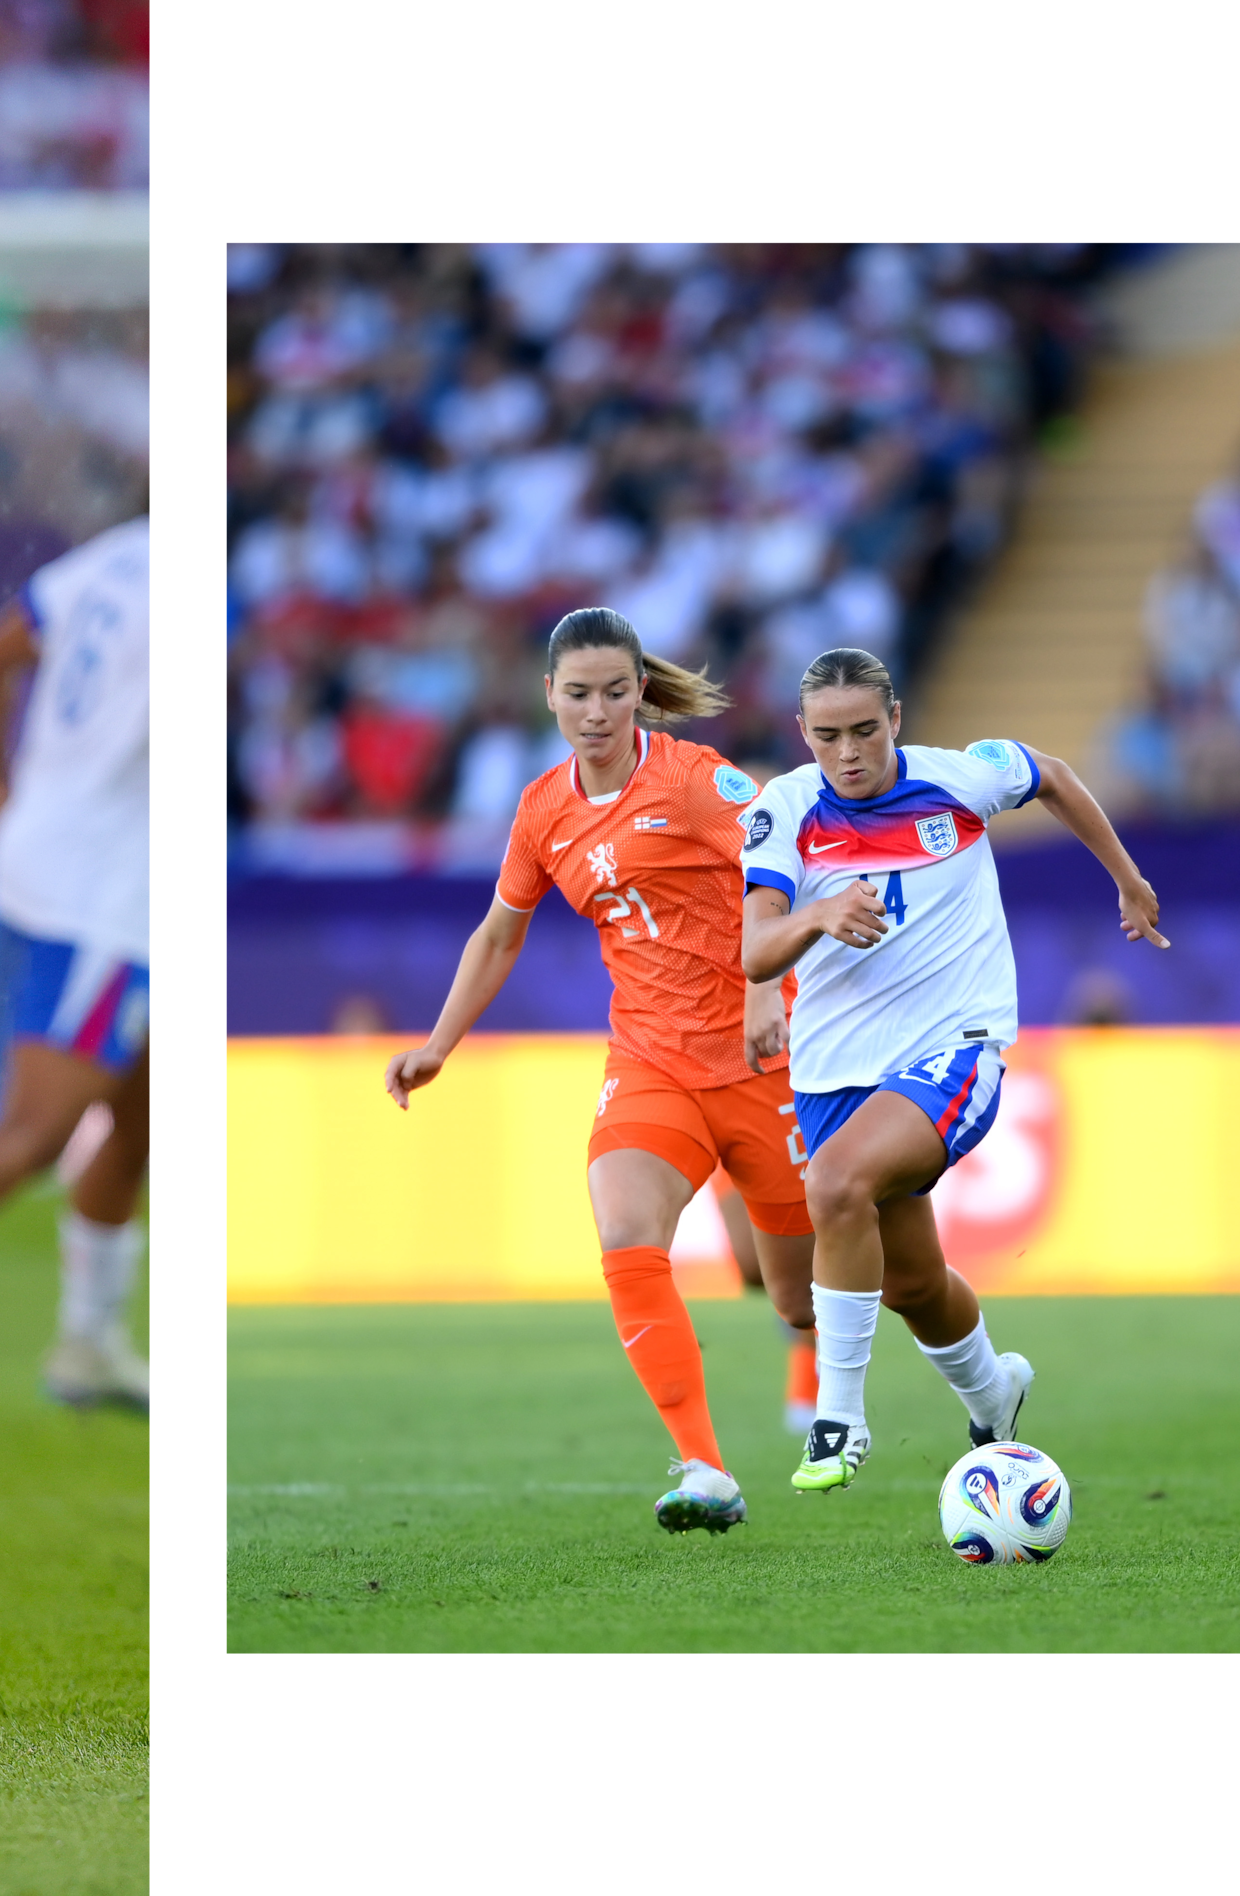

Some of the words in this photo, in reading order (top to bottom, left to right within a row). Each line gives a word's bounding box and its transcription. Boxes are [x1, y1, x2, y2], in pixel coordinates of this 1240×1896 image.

[593, 887, 659, 938] 21
[859, 870, 908, 926] 4
[901, 1048, 957, 1085] 4
